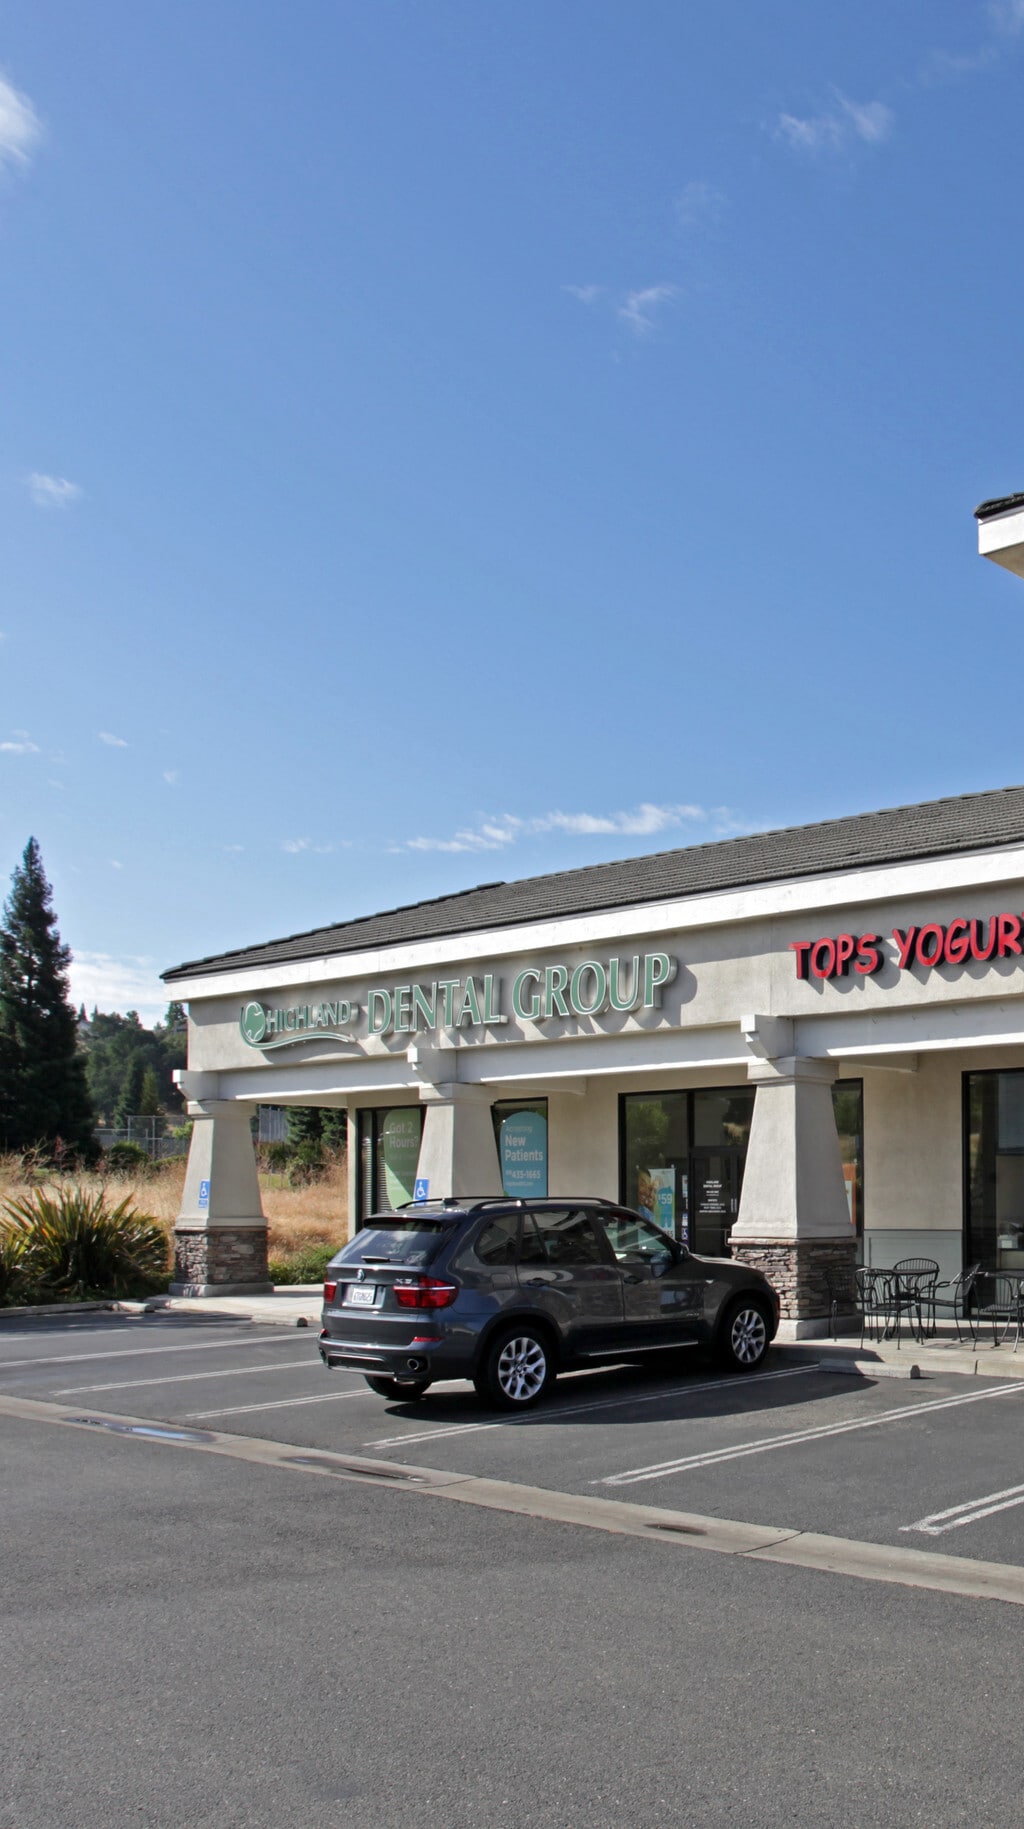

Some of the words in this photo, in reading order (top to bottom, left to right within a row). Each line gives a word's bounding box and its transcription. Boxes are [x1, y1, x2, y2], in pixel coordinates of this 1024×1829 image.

[789, 933, 884, 980] TOPS
[367, 974, 502, 1036] DENTAL
[512, 952, 673, 1021] GROUP
[266, 1000, 352, 1033] HIGHLAND
[504, 1134, 527, 1147] New
[504, 1149, 544, 1161] Patients
